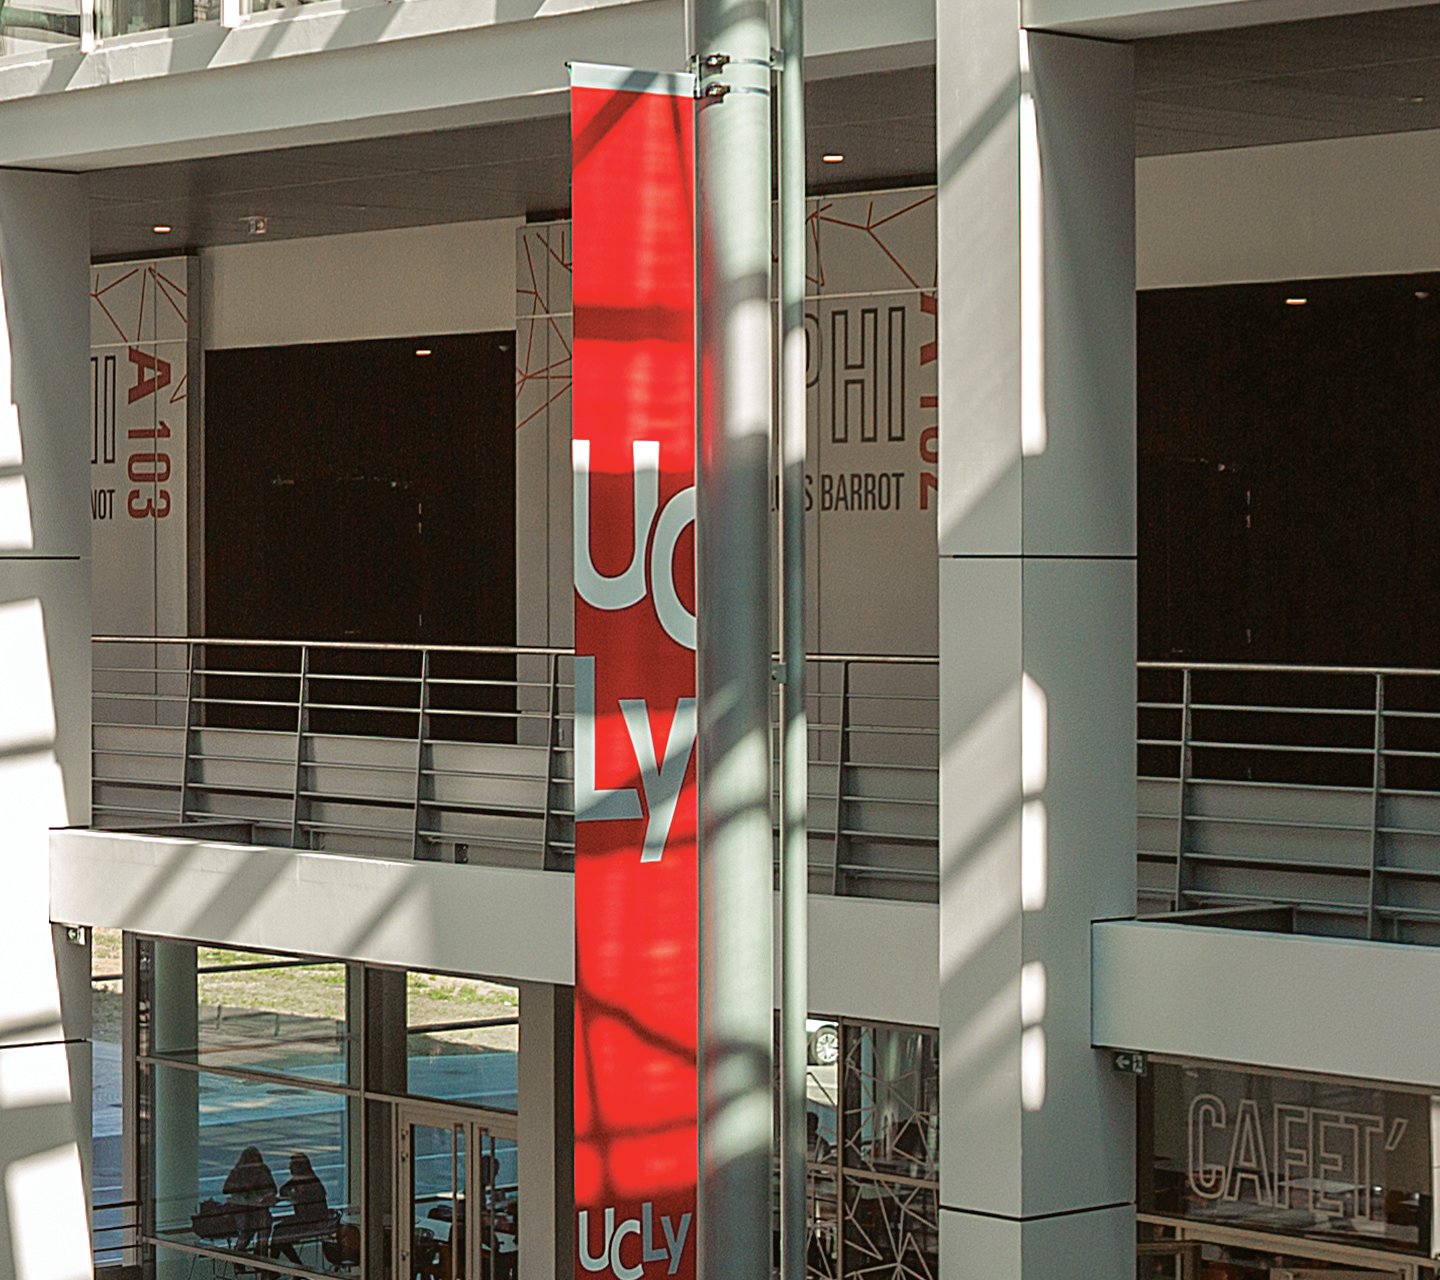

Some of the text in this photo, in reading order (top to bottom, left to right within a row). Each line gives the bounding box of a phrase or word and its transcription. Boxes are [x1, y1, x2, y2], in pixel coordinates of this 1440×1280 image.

[127, 346, 172, 519] A 103
[820, 473, 905, 511] BARROT
